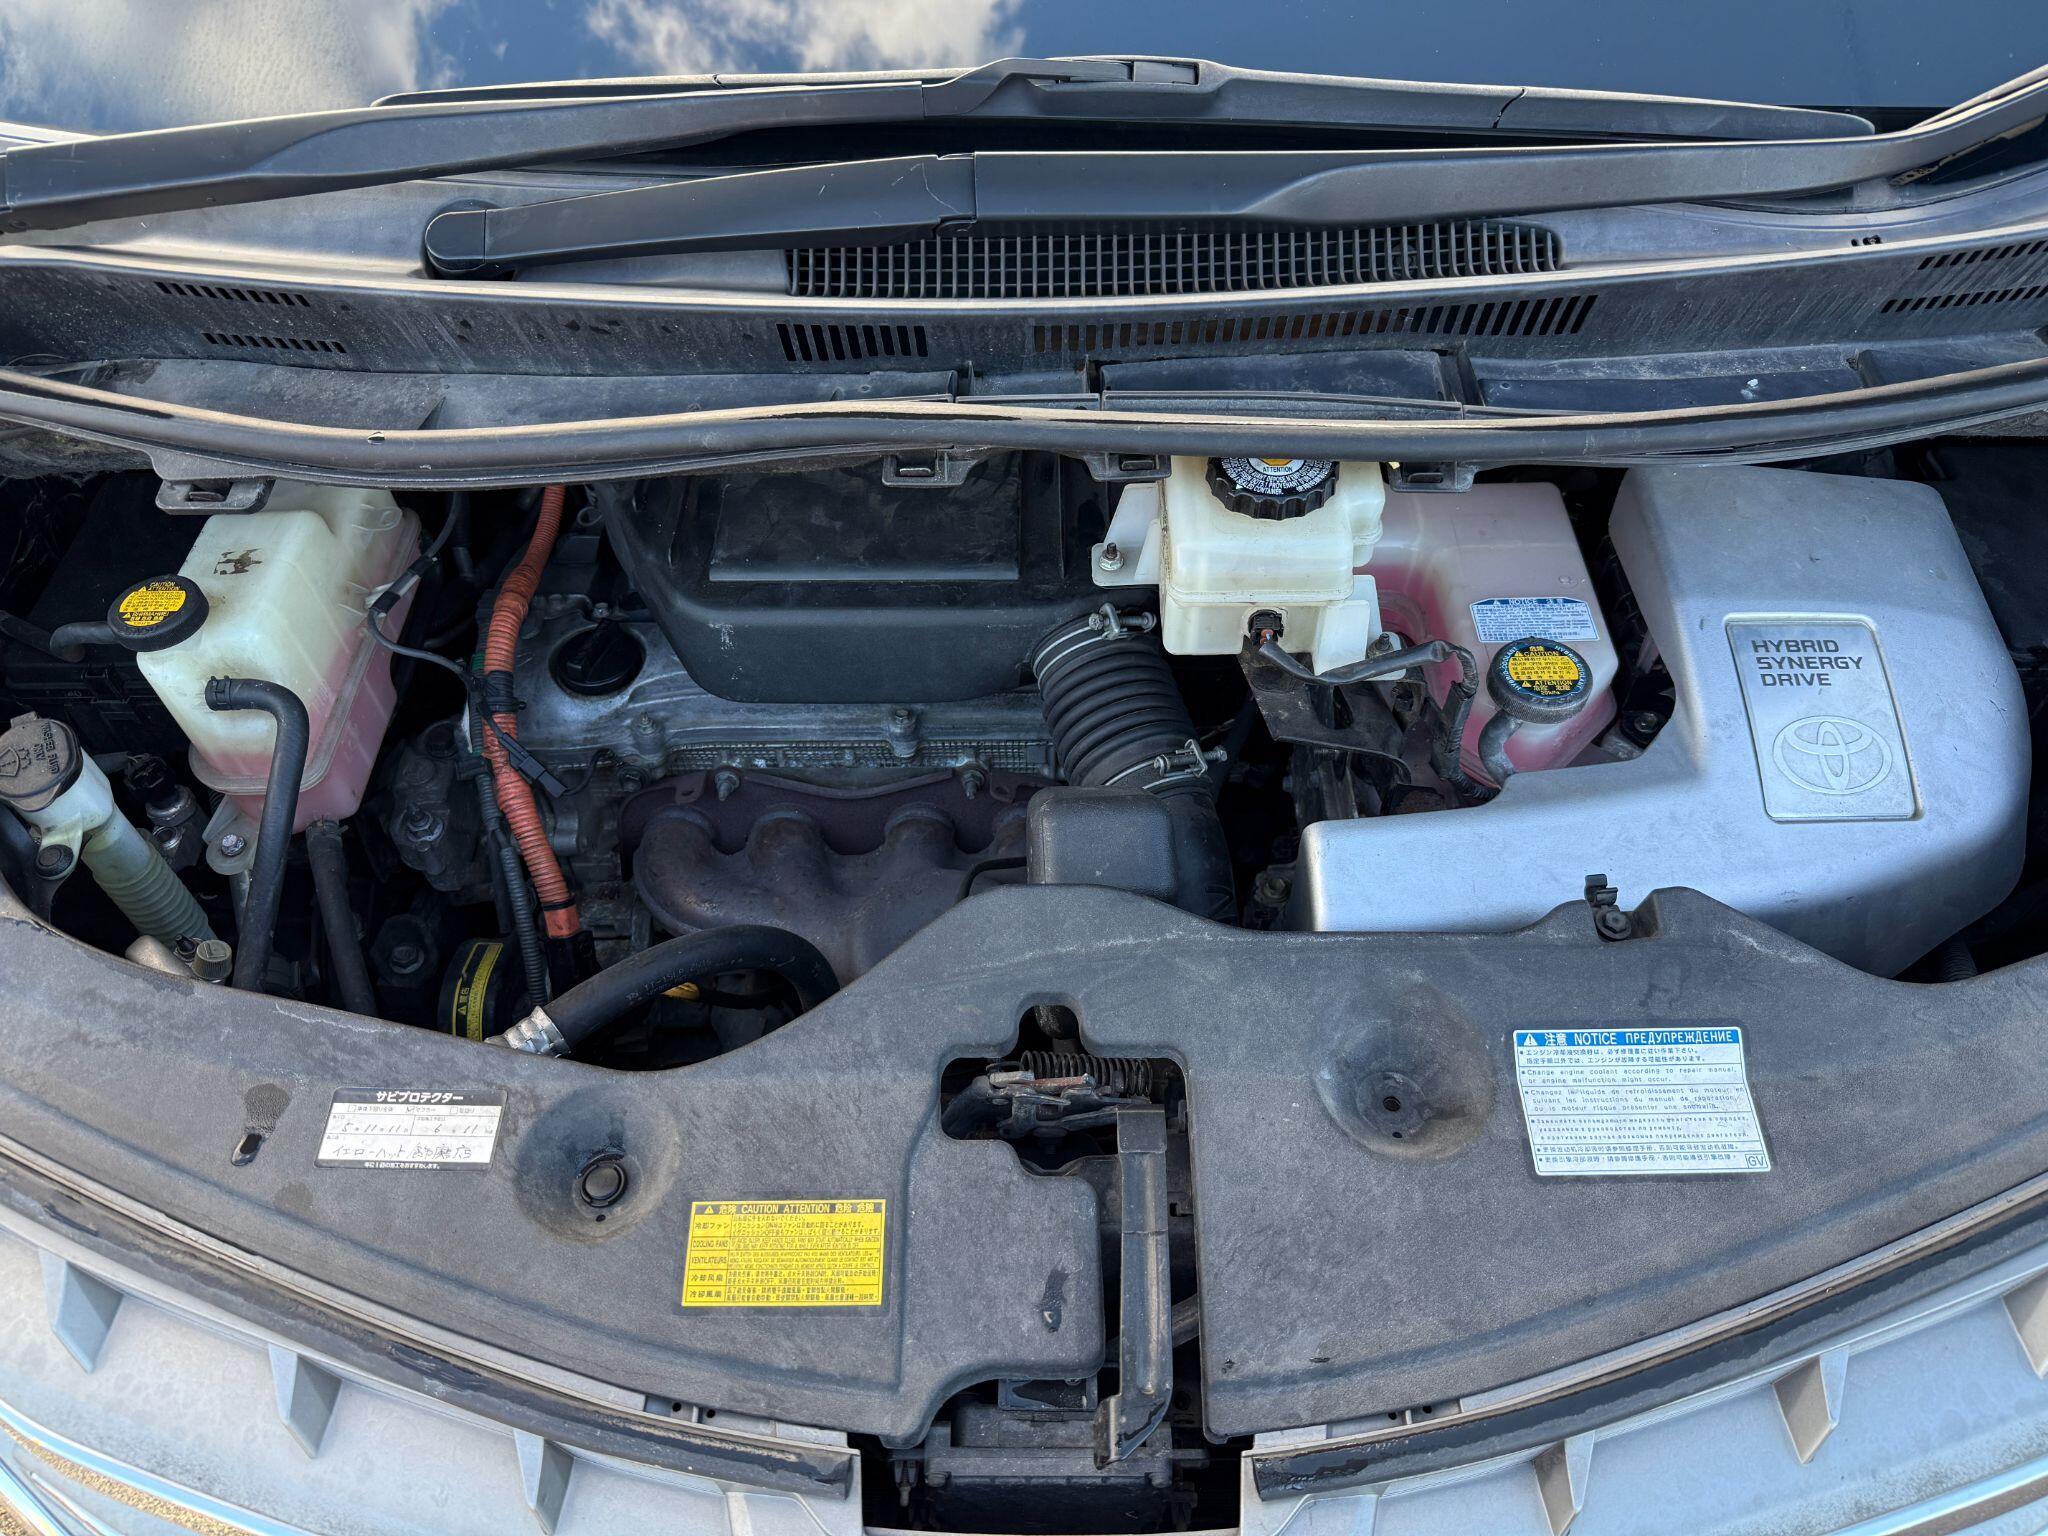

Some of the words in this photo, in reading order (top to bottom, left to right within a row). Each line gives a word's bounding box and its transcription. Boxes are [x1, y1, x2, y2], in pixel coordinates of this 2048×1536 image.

[1751, 639, 1839, 653] HYBRID
[1756, 656, 1863, 670] SYNERGY
[1760, 673, 1832, 687] DRIVE
[1544, 1032, 1568, 1046] 注意
[1574, 1032, 1617, 1045] NOTICE
[1625, 1030, 1734, 1045] ПРЕДУПРЕЖДЕНИЕ
[1623, 1067, 1660, 1075] according
[376, 1090, 463, 1103] サビプロテクター
[1748, 1155, 1764, 1167] GV
[741, 1204, 779, 1214] CAUTION
[783, 1203, 830, 1213] ATTENTION
[695, 1222, 730, 1230] 冷却ファン
[692, 1256, 727, 1264] VENTILATEURS
